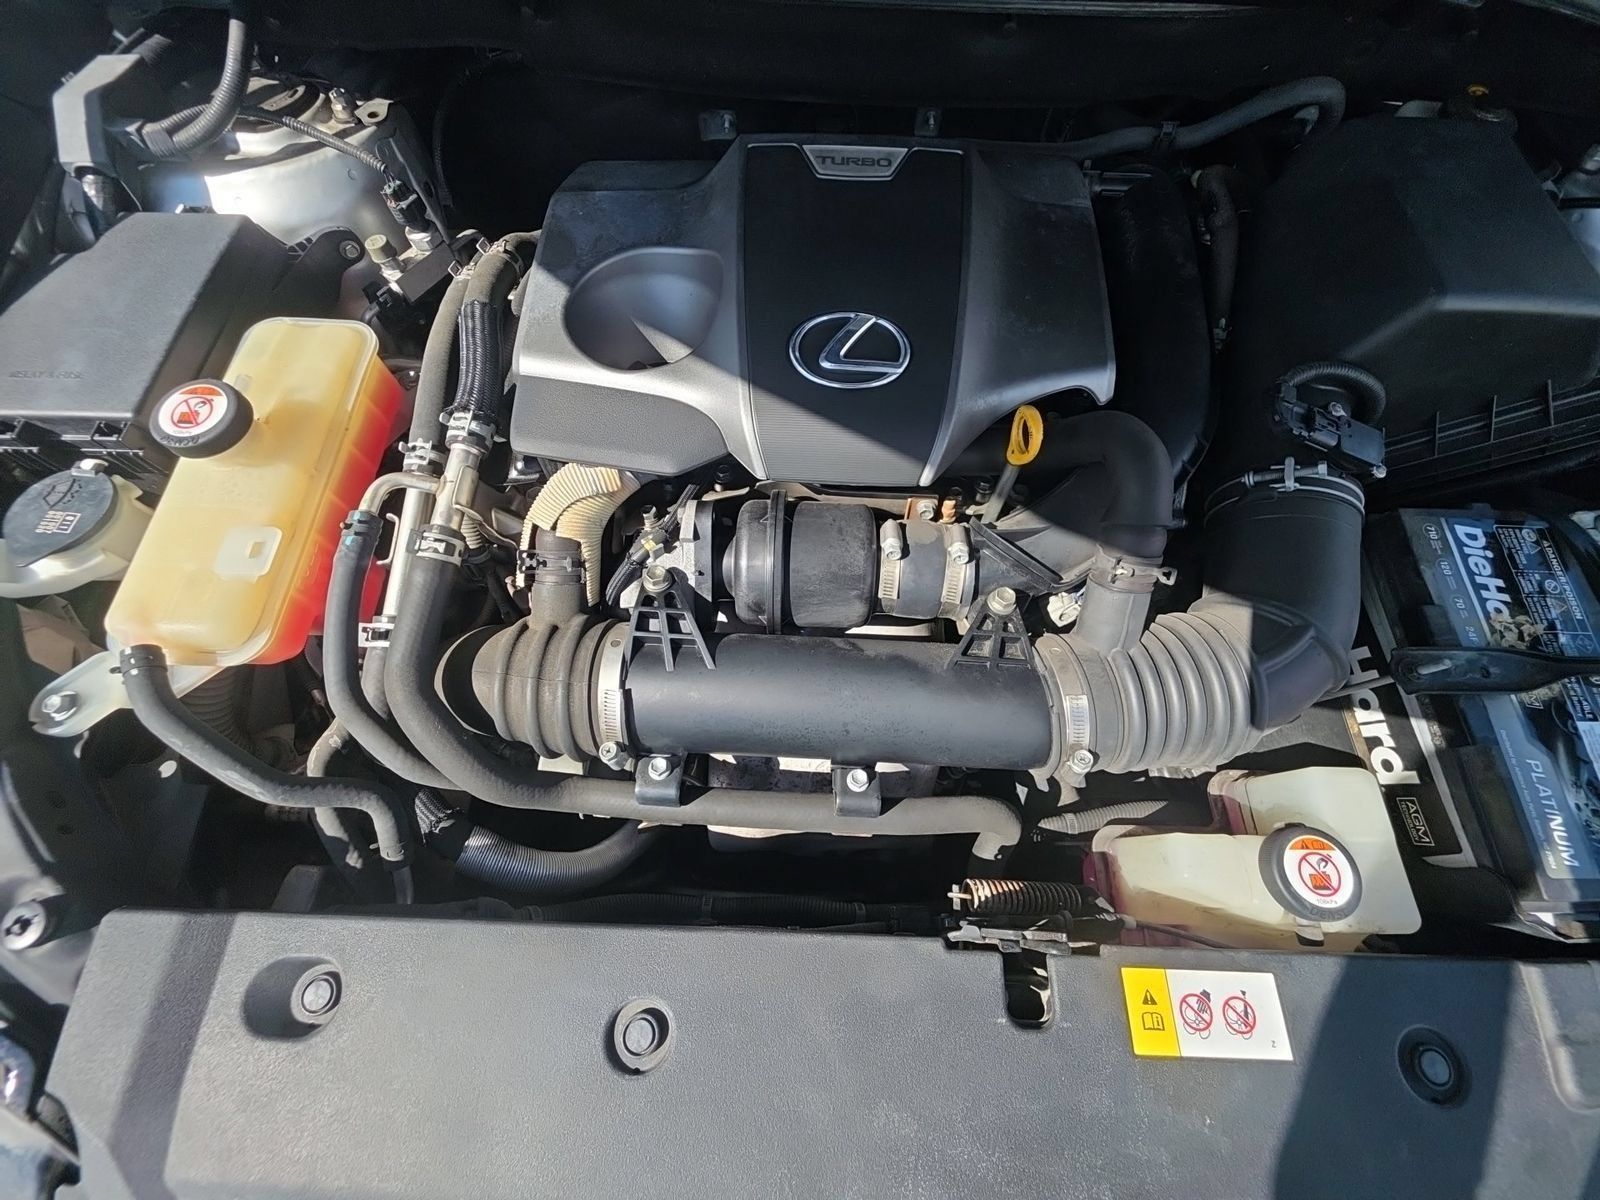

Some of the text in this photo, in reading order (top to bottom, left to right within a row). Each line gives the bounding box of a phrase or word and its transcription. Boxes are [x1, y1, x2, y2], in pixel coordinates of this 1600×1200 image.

[815, 155, 892, 168] TURBO
[1426, 526, 1438, 540] 710
[1440, 561, 1452, 575] 120
[1453, 524, 1514, 622] DieHa
[1454, 598, 1465, 609] 70
[1400, 801, 1420, 841] TECHNOLOGY
[1406, 801, 1431, 842] AGM
[1526, 758, 1580, 867] PLATINUM
